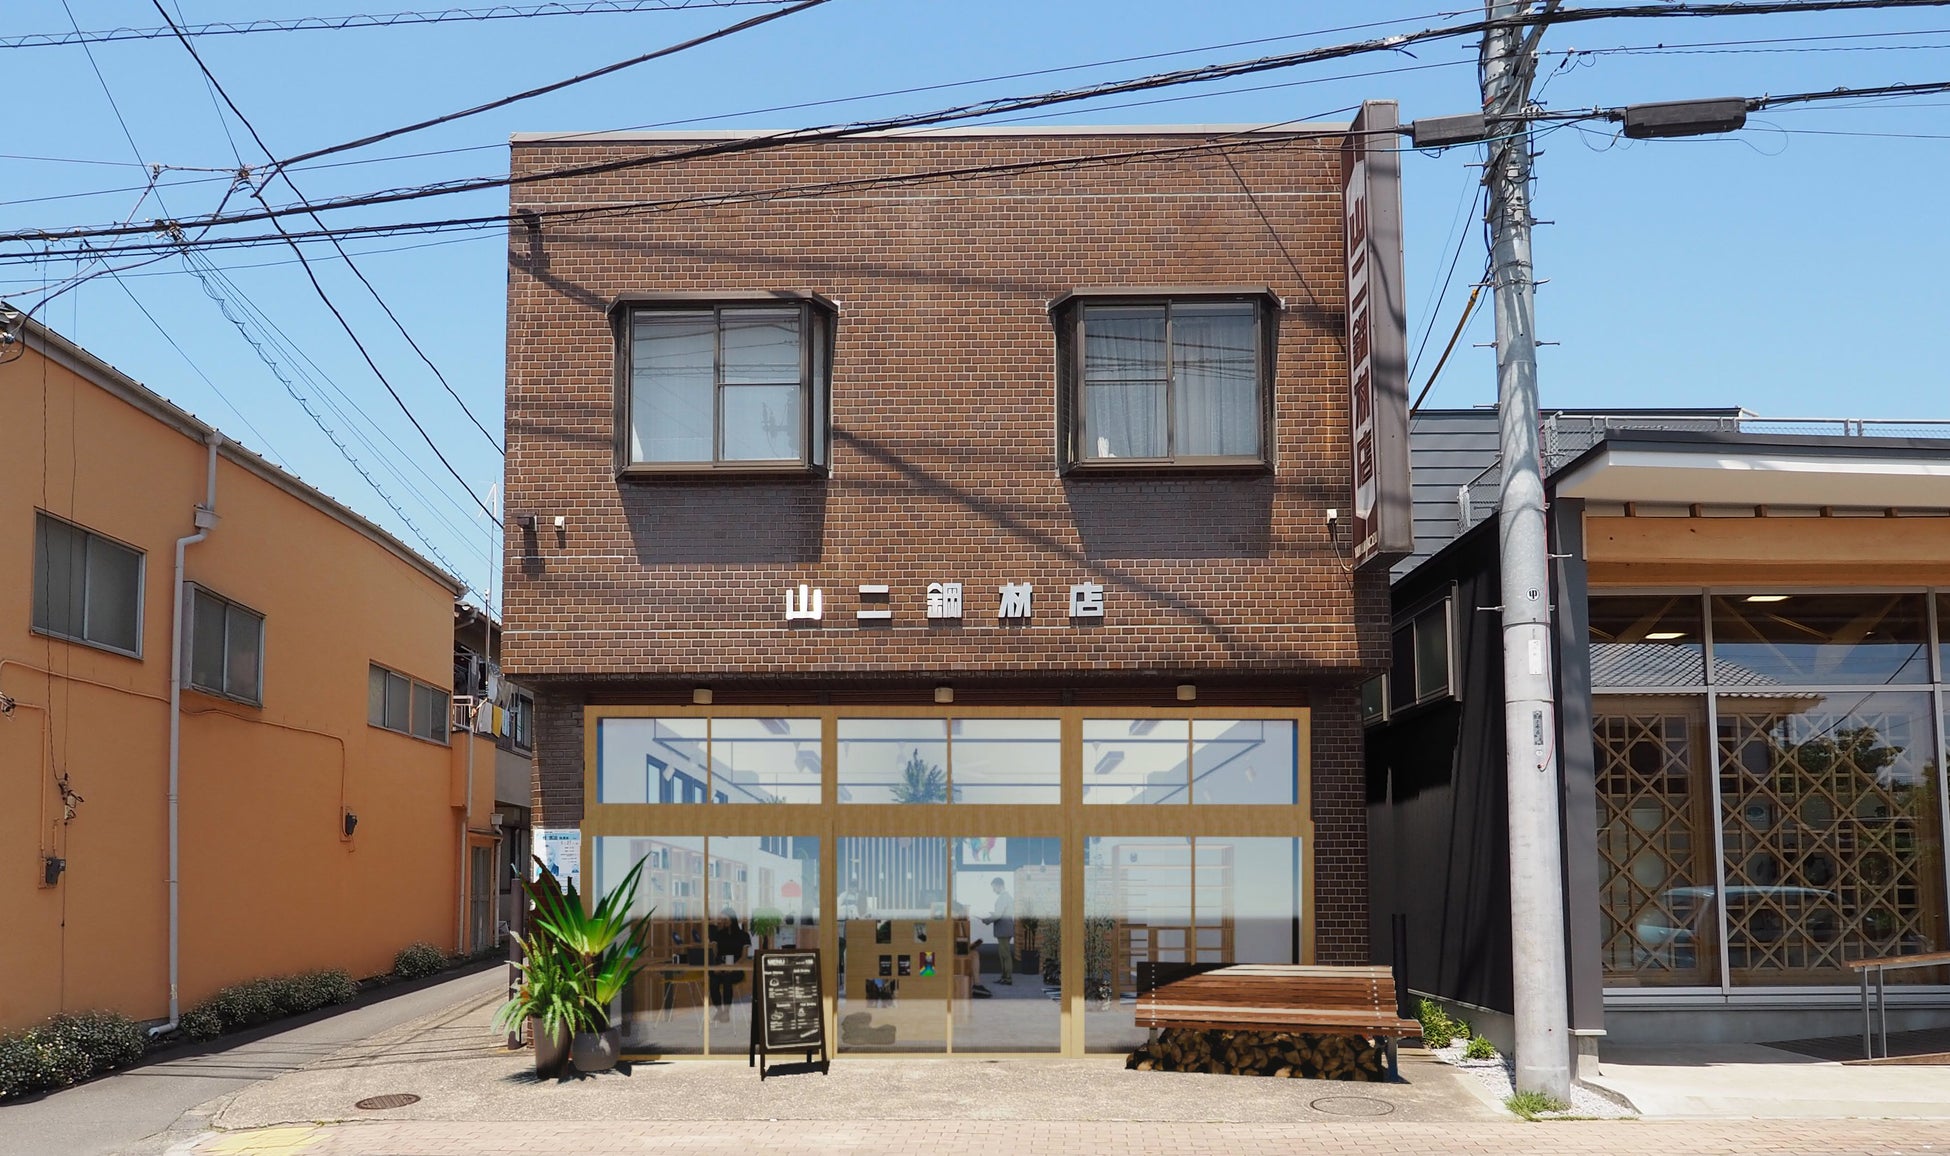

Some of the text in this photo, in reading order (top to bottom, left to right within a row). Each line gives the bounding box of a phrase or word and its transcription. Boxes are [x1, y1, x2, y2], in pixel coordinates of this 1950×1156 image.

[1350, 195, 1372, 490] 山二鋼材店
[786, 581, 1104, 620] 山二鋼材店
